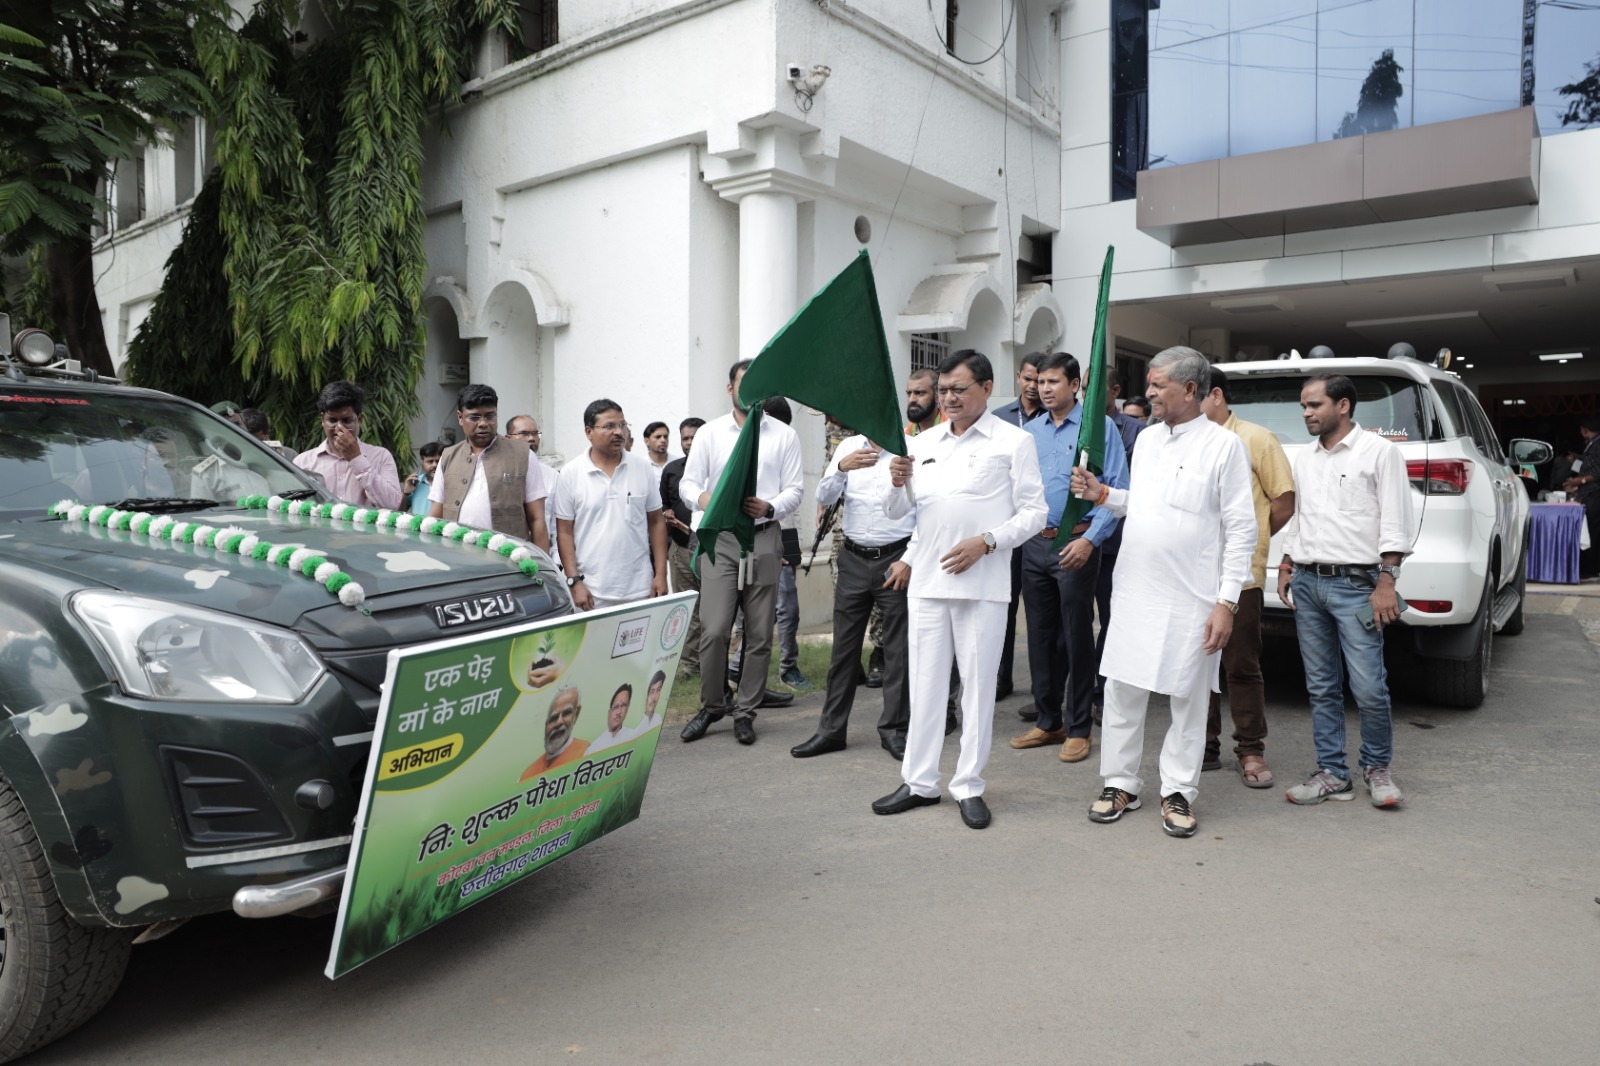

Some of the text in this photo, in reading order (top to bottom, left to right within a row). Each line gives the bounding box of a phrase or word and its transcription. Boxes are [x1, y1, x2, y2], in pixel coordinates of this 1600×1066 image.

[434, 593, 515, 627] ISUZU
[424, 654, 496, 692] एक पेड़
[398, 687, 503, 733] मां के नाम
[389, 742, 454, 773] अभियान
[461, 795, 522, 845] शुल्क
[525, 777, 570, 808] पौधा
[572, 749, 634, 790] वितरण
[437, 859, 476, 886] कोरबा
[477, 849, 497, 866] वन
[536, 817, 564, 838] जिला
[460, 831, 573, 898] छत्तीसगढ़ शासन
